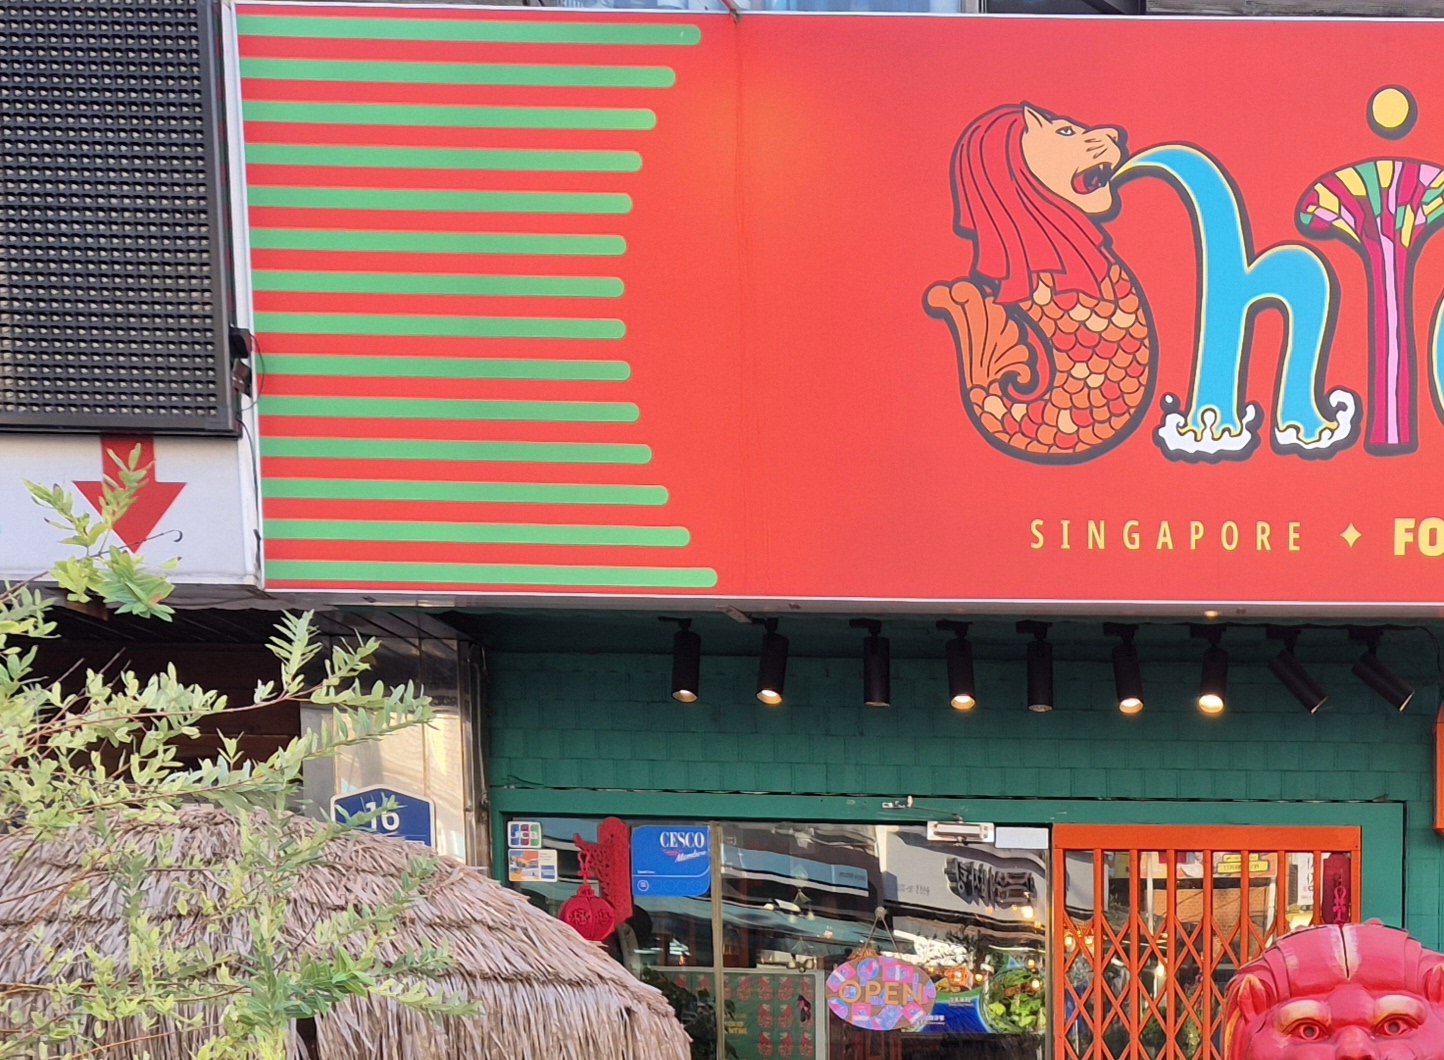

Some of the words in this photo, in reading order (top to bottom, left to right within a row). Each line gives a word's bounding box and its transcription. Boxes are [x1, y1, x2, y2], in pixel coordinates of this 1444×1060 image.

[1030, 518, 1302, 551] SINGAPORE
[365, 801, 401, 832] 16
[660, 831, 705, 848] CESCO
[839, 980, 924, 1006] OPEN
